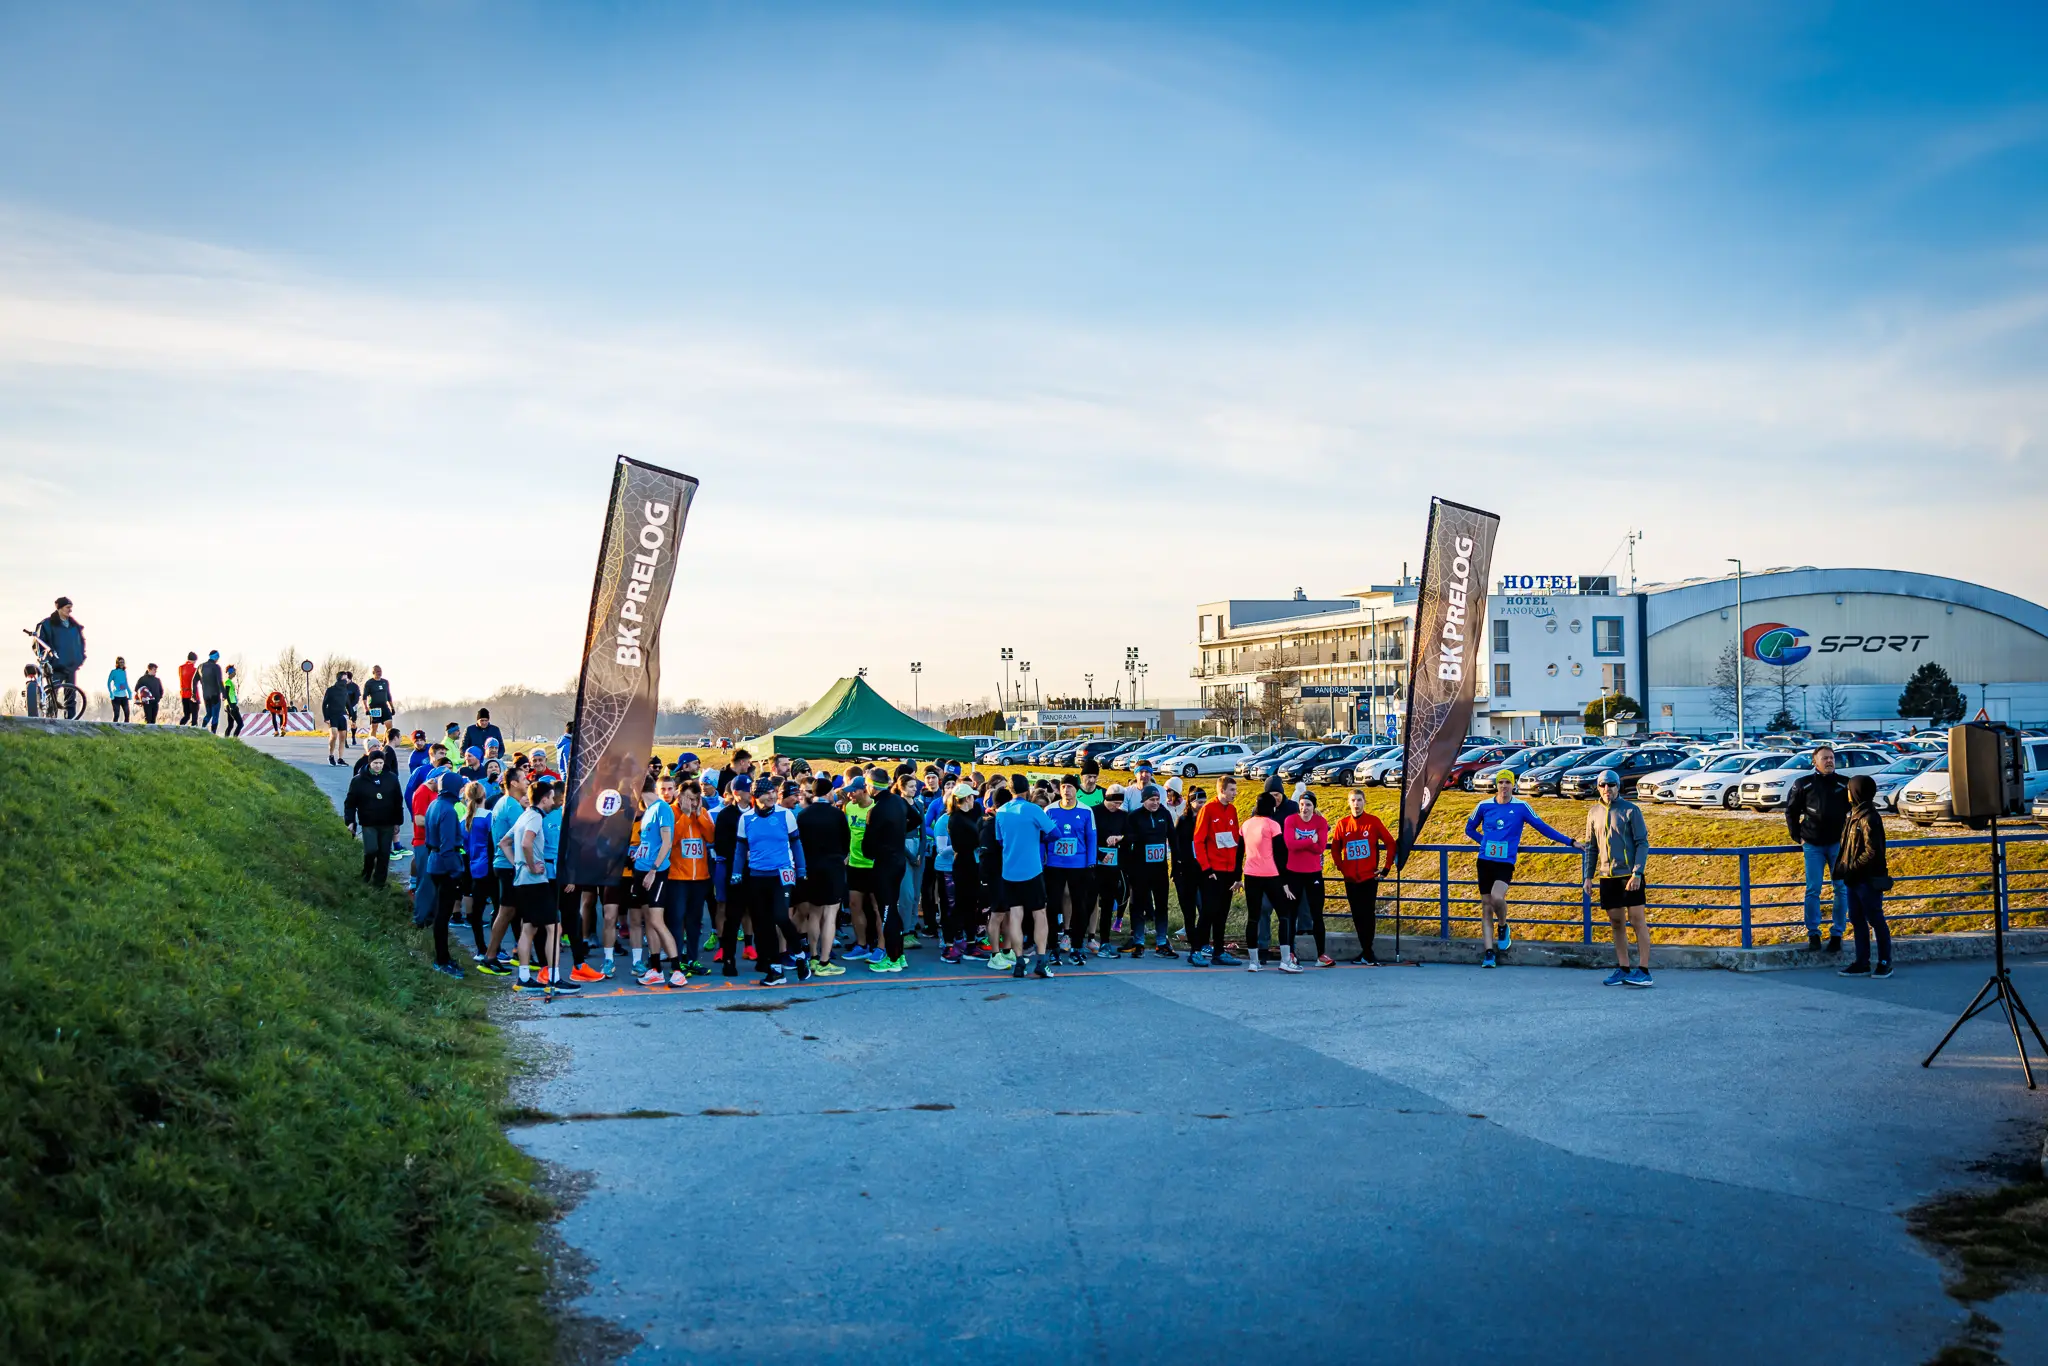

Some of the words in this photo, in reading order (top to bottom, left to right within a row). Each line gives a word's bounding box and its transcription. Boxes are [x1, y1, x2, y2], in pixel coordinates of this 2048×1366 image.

[621, 501, 670, 623] PRELOG
[1503, 575, 1577, 589] HOTEL
[1442, 536, 1473, 642] PRELOG
[1506, 597, 1548, 606] HOTEL
[1500, 607, 1556, 616] PANORAMA
[616, 623, 641, 667] BK
[1818, 636, 1929, 653] SPORT
[1438, 643, 1463, 681] BK
[1042, 713, 1077, 721] PANORAMA
[862, 742, 877, 751] BK
[879, 742, 920, 753] PRELOG
[684, 843, 703, 856] 793
[1056, 843, 1075, 855] 281
[1147, 848, 1164, 860] 502
[1348, 844, 1368, 858] 593
[1489, 844, 1503, 857] 31
